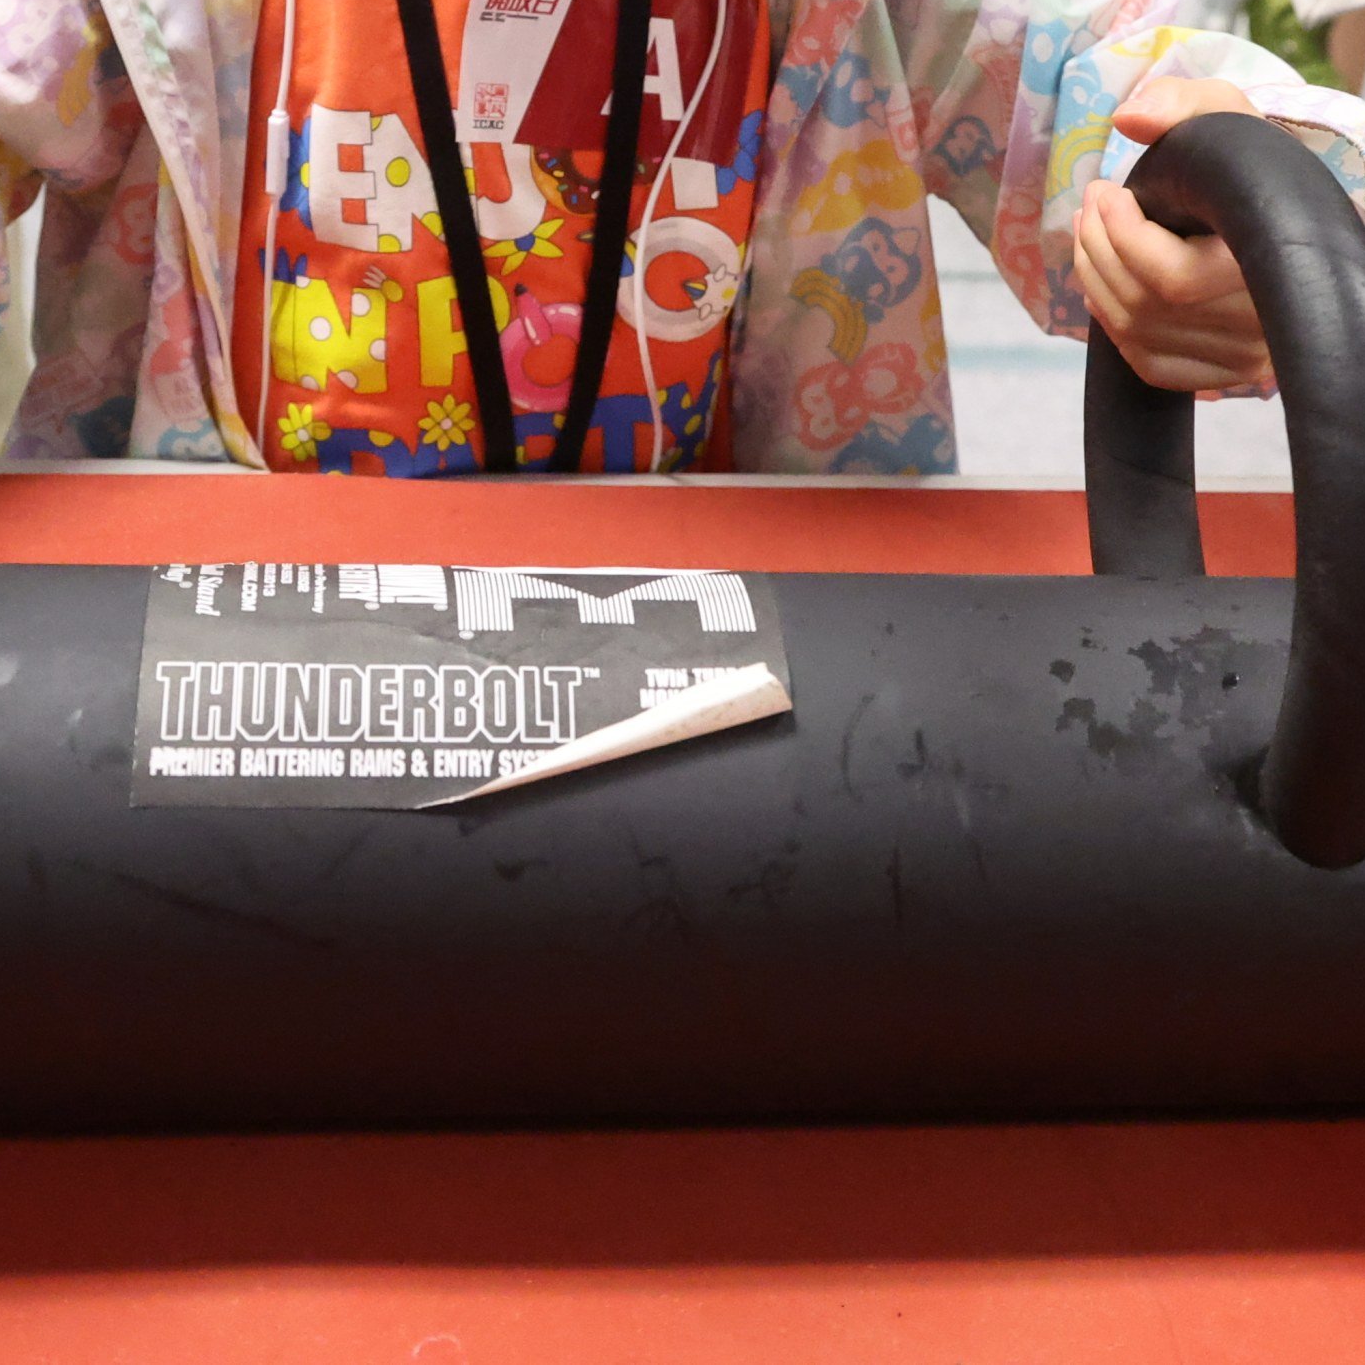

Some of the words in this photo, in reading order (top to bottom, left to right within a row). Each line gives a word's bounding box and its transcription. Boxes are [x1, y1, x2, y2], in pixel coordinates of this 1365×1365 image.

[601, 17, 685, 121] A
[472, 119, 504, 130] ICAC
[644, 668, 689, 688] TWIN
[149, 746, 235, 777] PREMIER
[239, 748, 345, 777] BATTERING
[349, 748, 406, 778] RAMS
[410, 748, 429, 777] &
[433, 749, 494, 778] ENTRY
